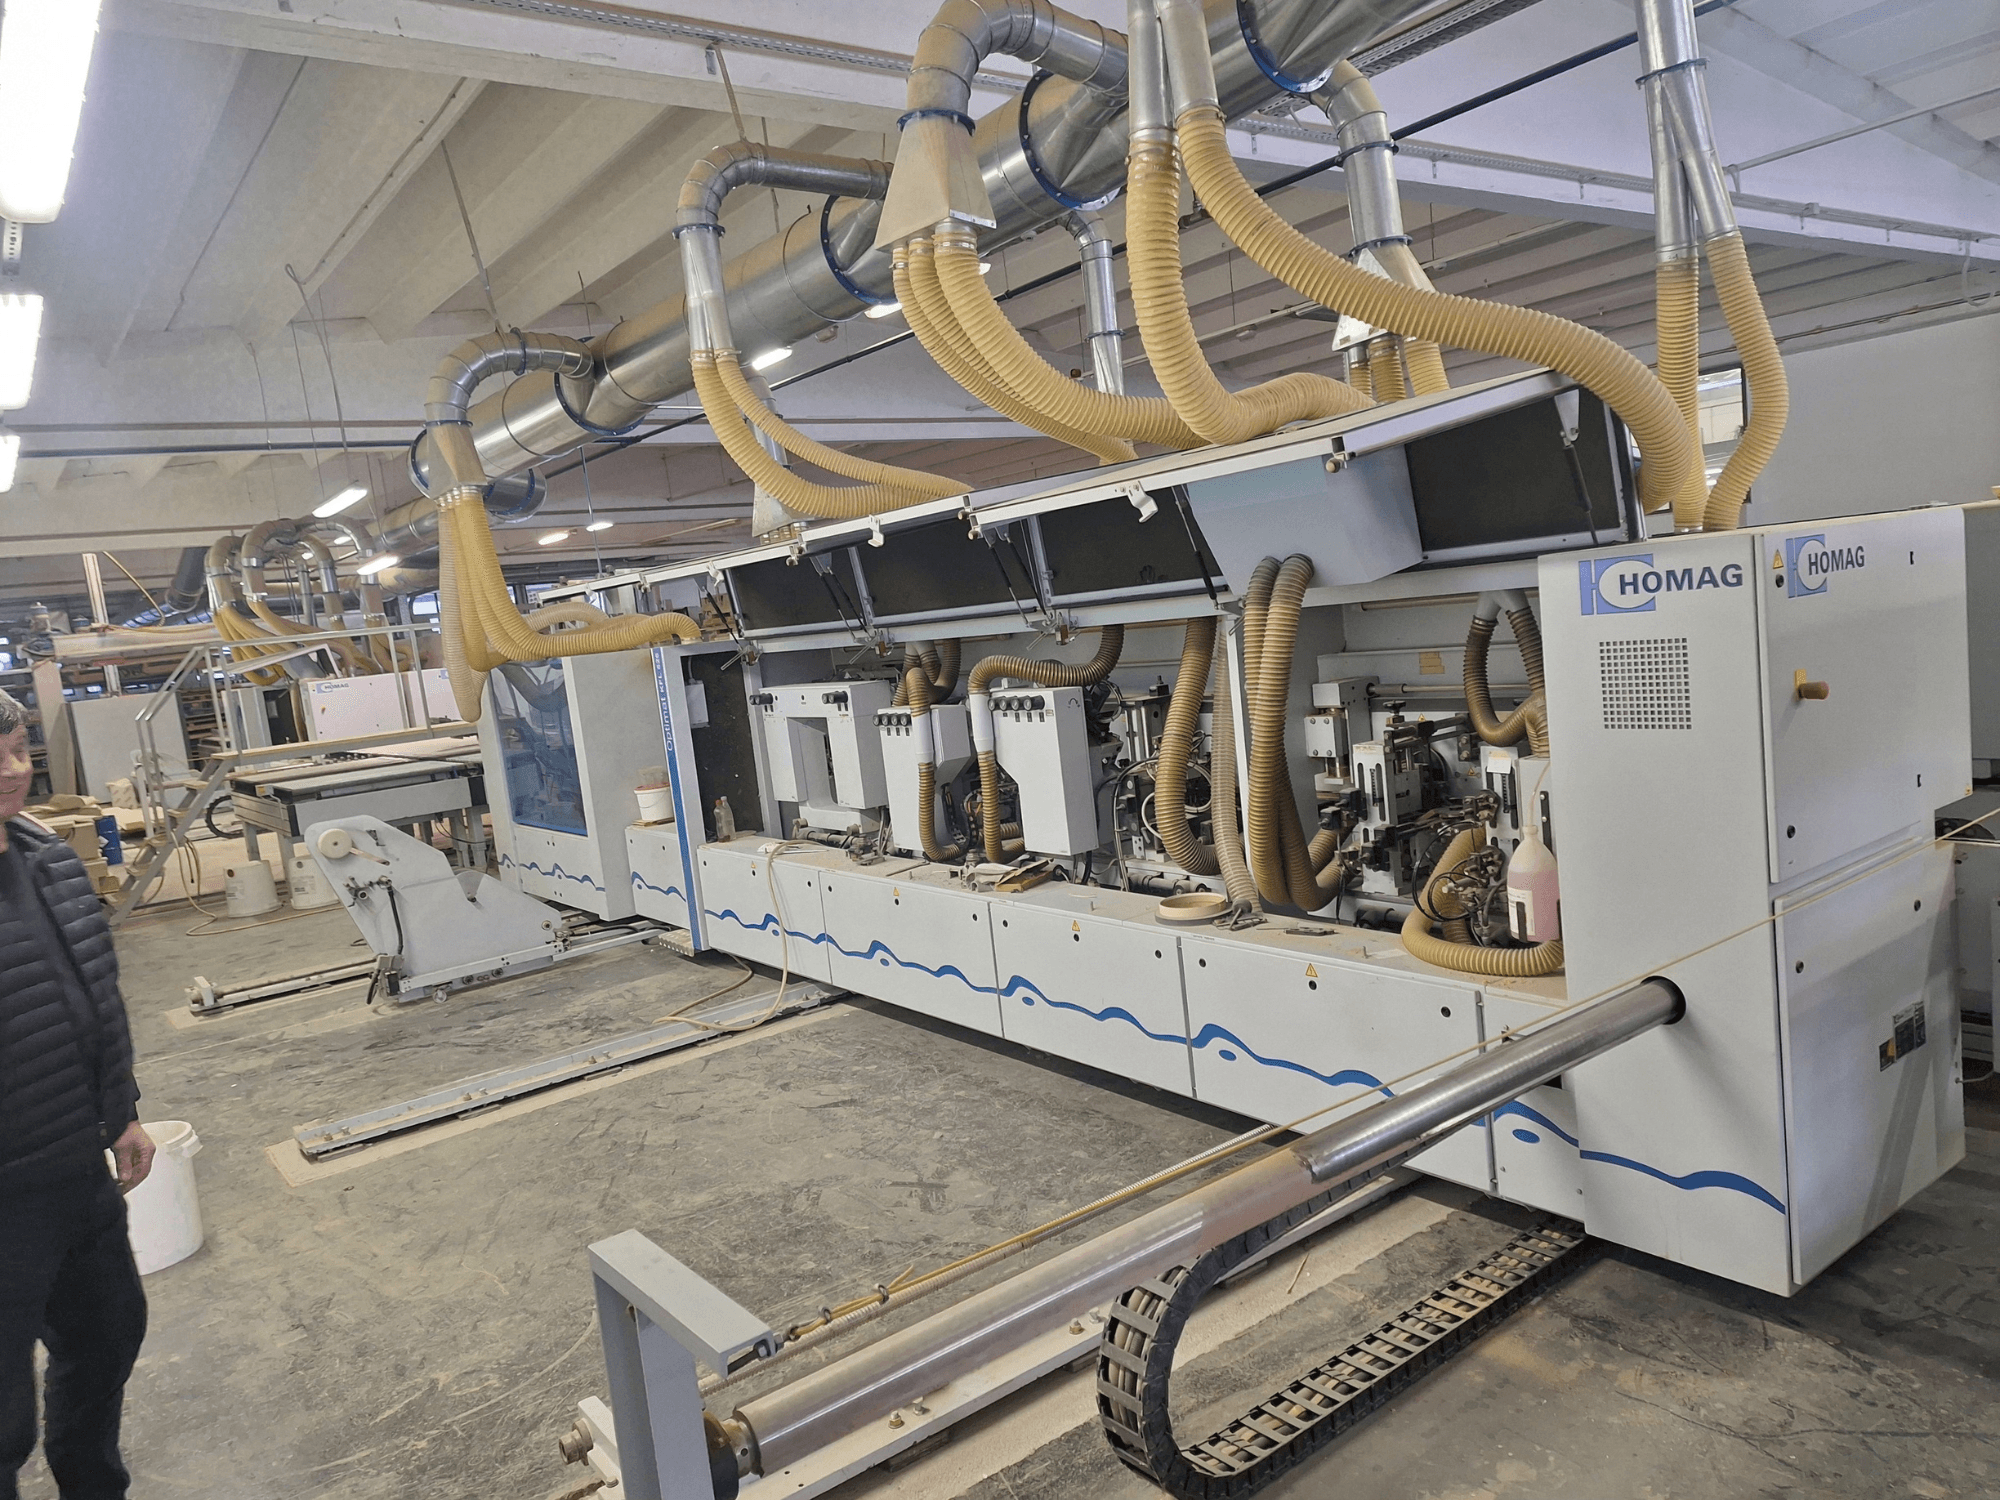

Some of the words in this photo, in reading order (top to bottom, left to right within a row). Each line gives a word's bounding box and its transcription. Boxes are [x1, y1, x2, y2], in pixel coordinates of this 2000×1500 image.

[1808, 545, 1865, 576] HOMAG
[1619, 563, 1743, 596] HOMAG
[661, 697, 673, 751] Optimat
